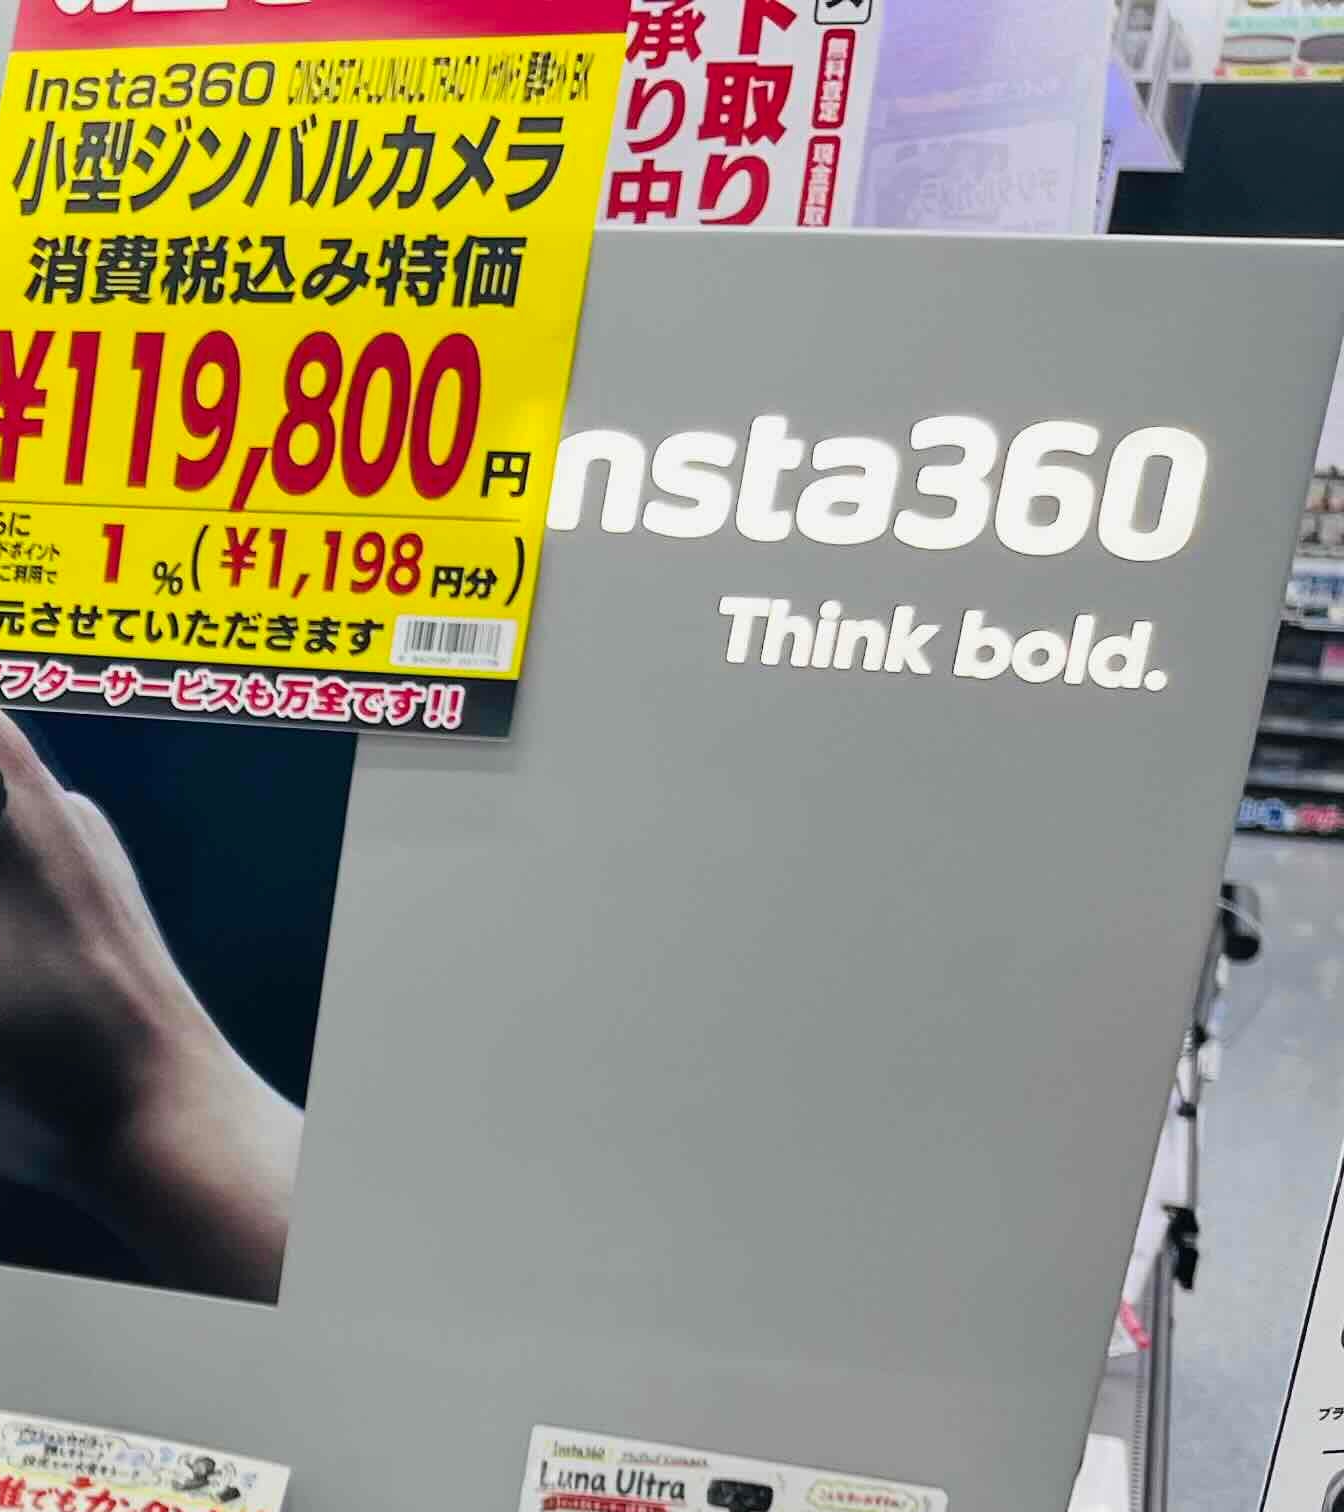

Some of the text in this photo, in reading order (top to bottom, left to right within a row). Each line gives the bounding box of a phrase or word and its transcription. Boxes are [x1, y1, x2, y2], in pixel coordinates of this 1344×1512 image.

[24, 59, 275, 114] Insta360
[12, 114, 566, 216] 小型ジンバルカメラ
[24, 234, 527, 308] 消費税込み特価
[481, 451, 530, 498] 円
[546, 415, 1208, 562] nsta360
[100, 523, 125, 583] 1
[220, 527, 424, 598] ¥1,198
[431, 564, 497, 598] 円分
[719, 595, 1167, 690] Think bold.
[1319, 1406, 1344, 1421] ブラ
[540, 1460, 685, 1500] Luna Ultra
